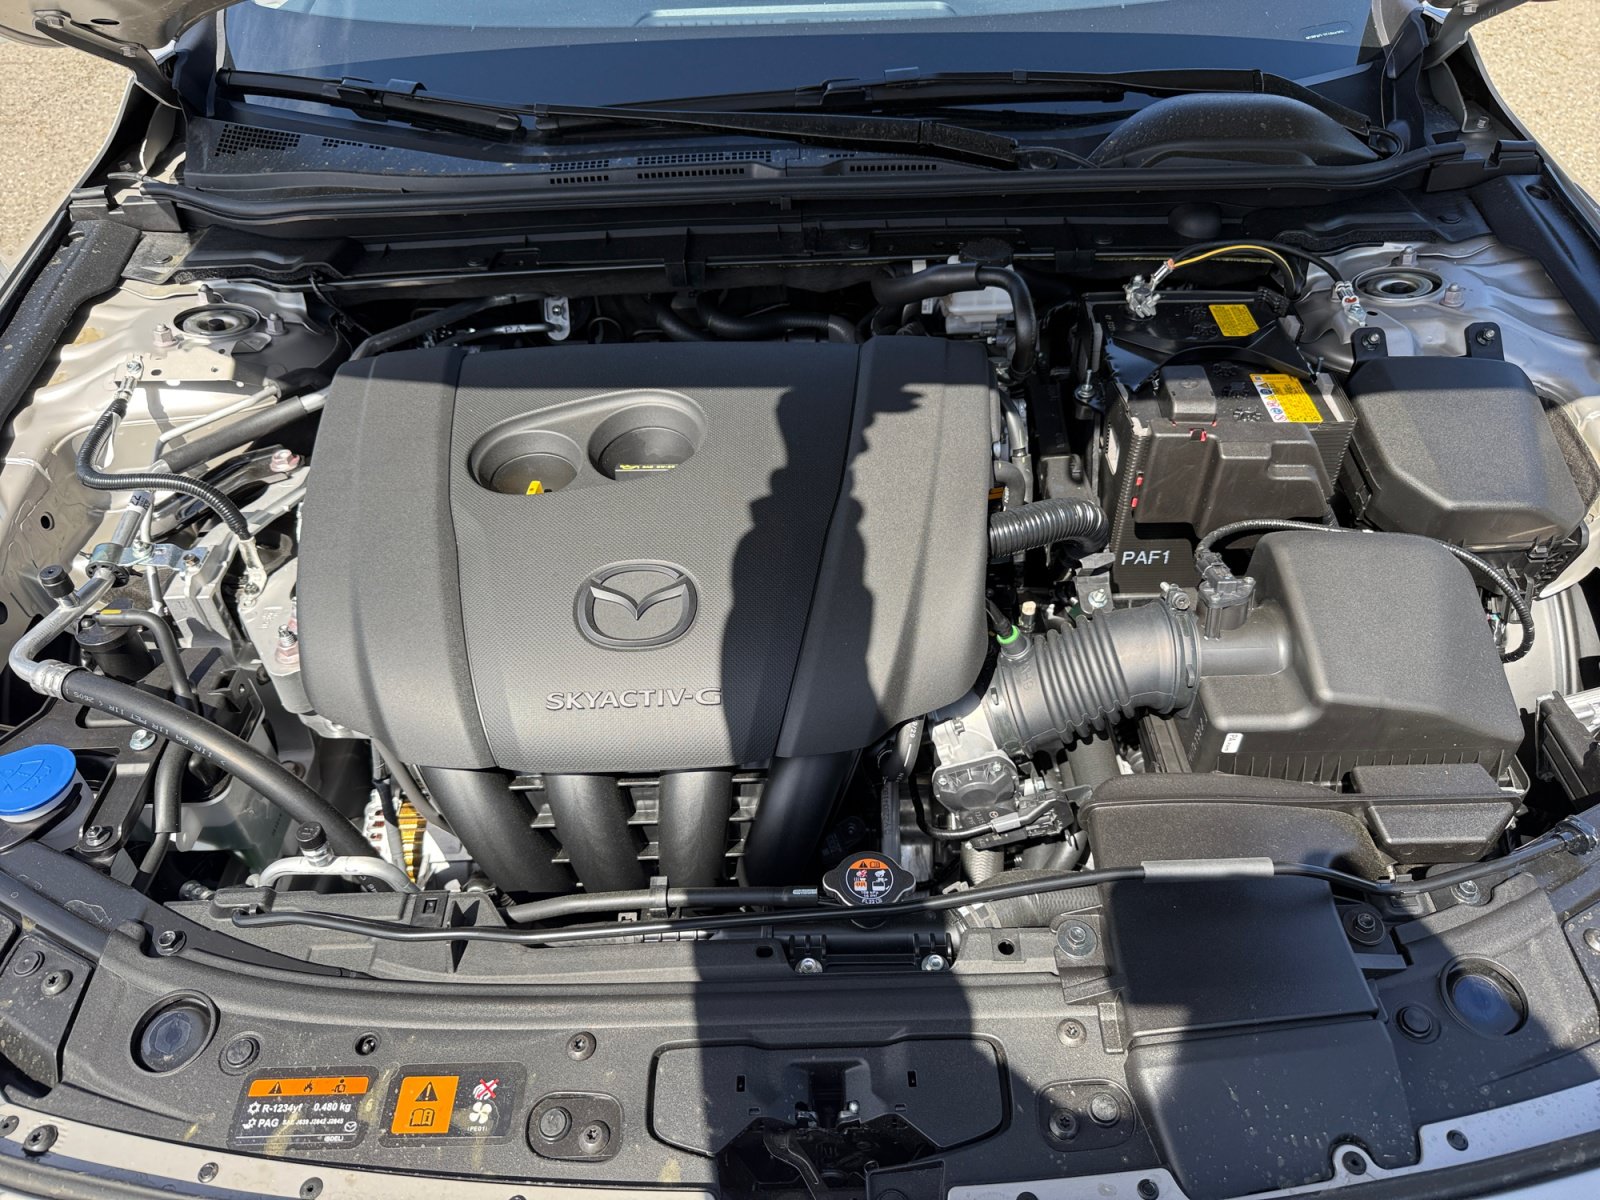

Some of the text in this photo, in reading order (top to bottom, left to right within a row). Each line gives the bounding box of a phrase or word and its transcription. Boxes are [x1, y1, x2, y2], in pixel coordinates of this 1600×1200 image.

[1121, 550, 1170, 566] PAF1
[546, 687, 722, 710] SKYACTIV-G
[262, 1102, 352, 1114] R-1234yf 0.480 kg
[257, 1118, 280, 1128] PAG
